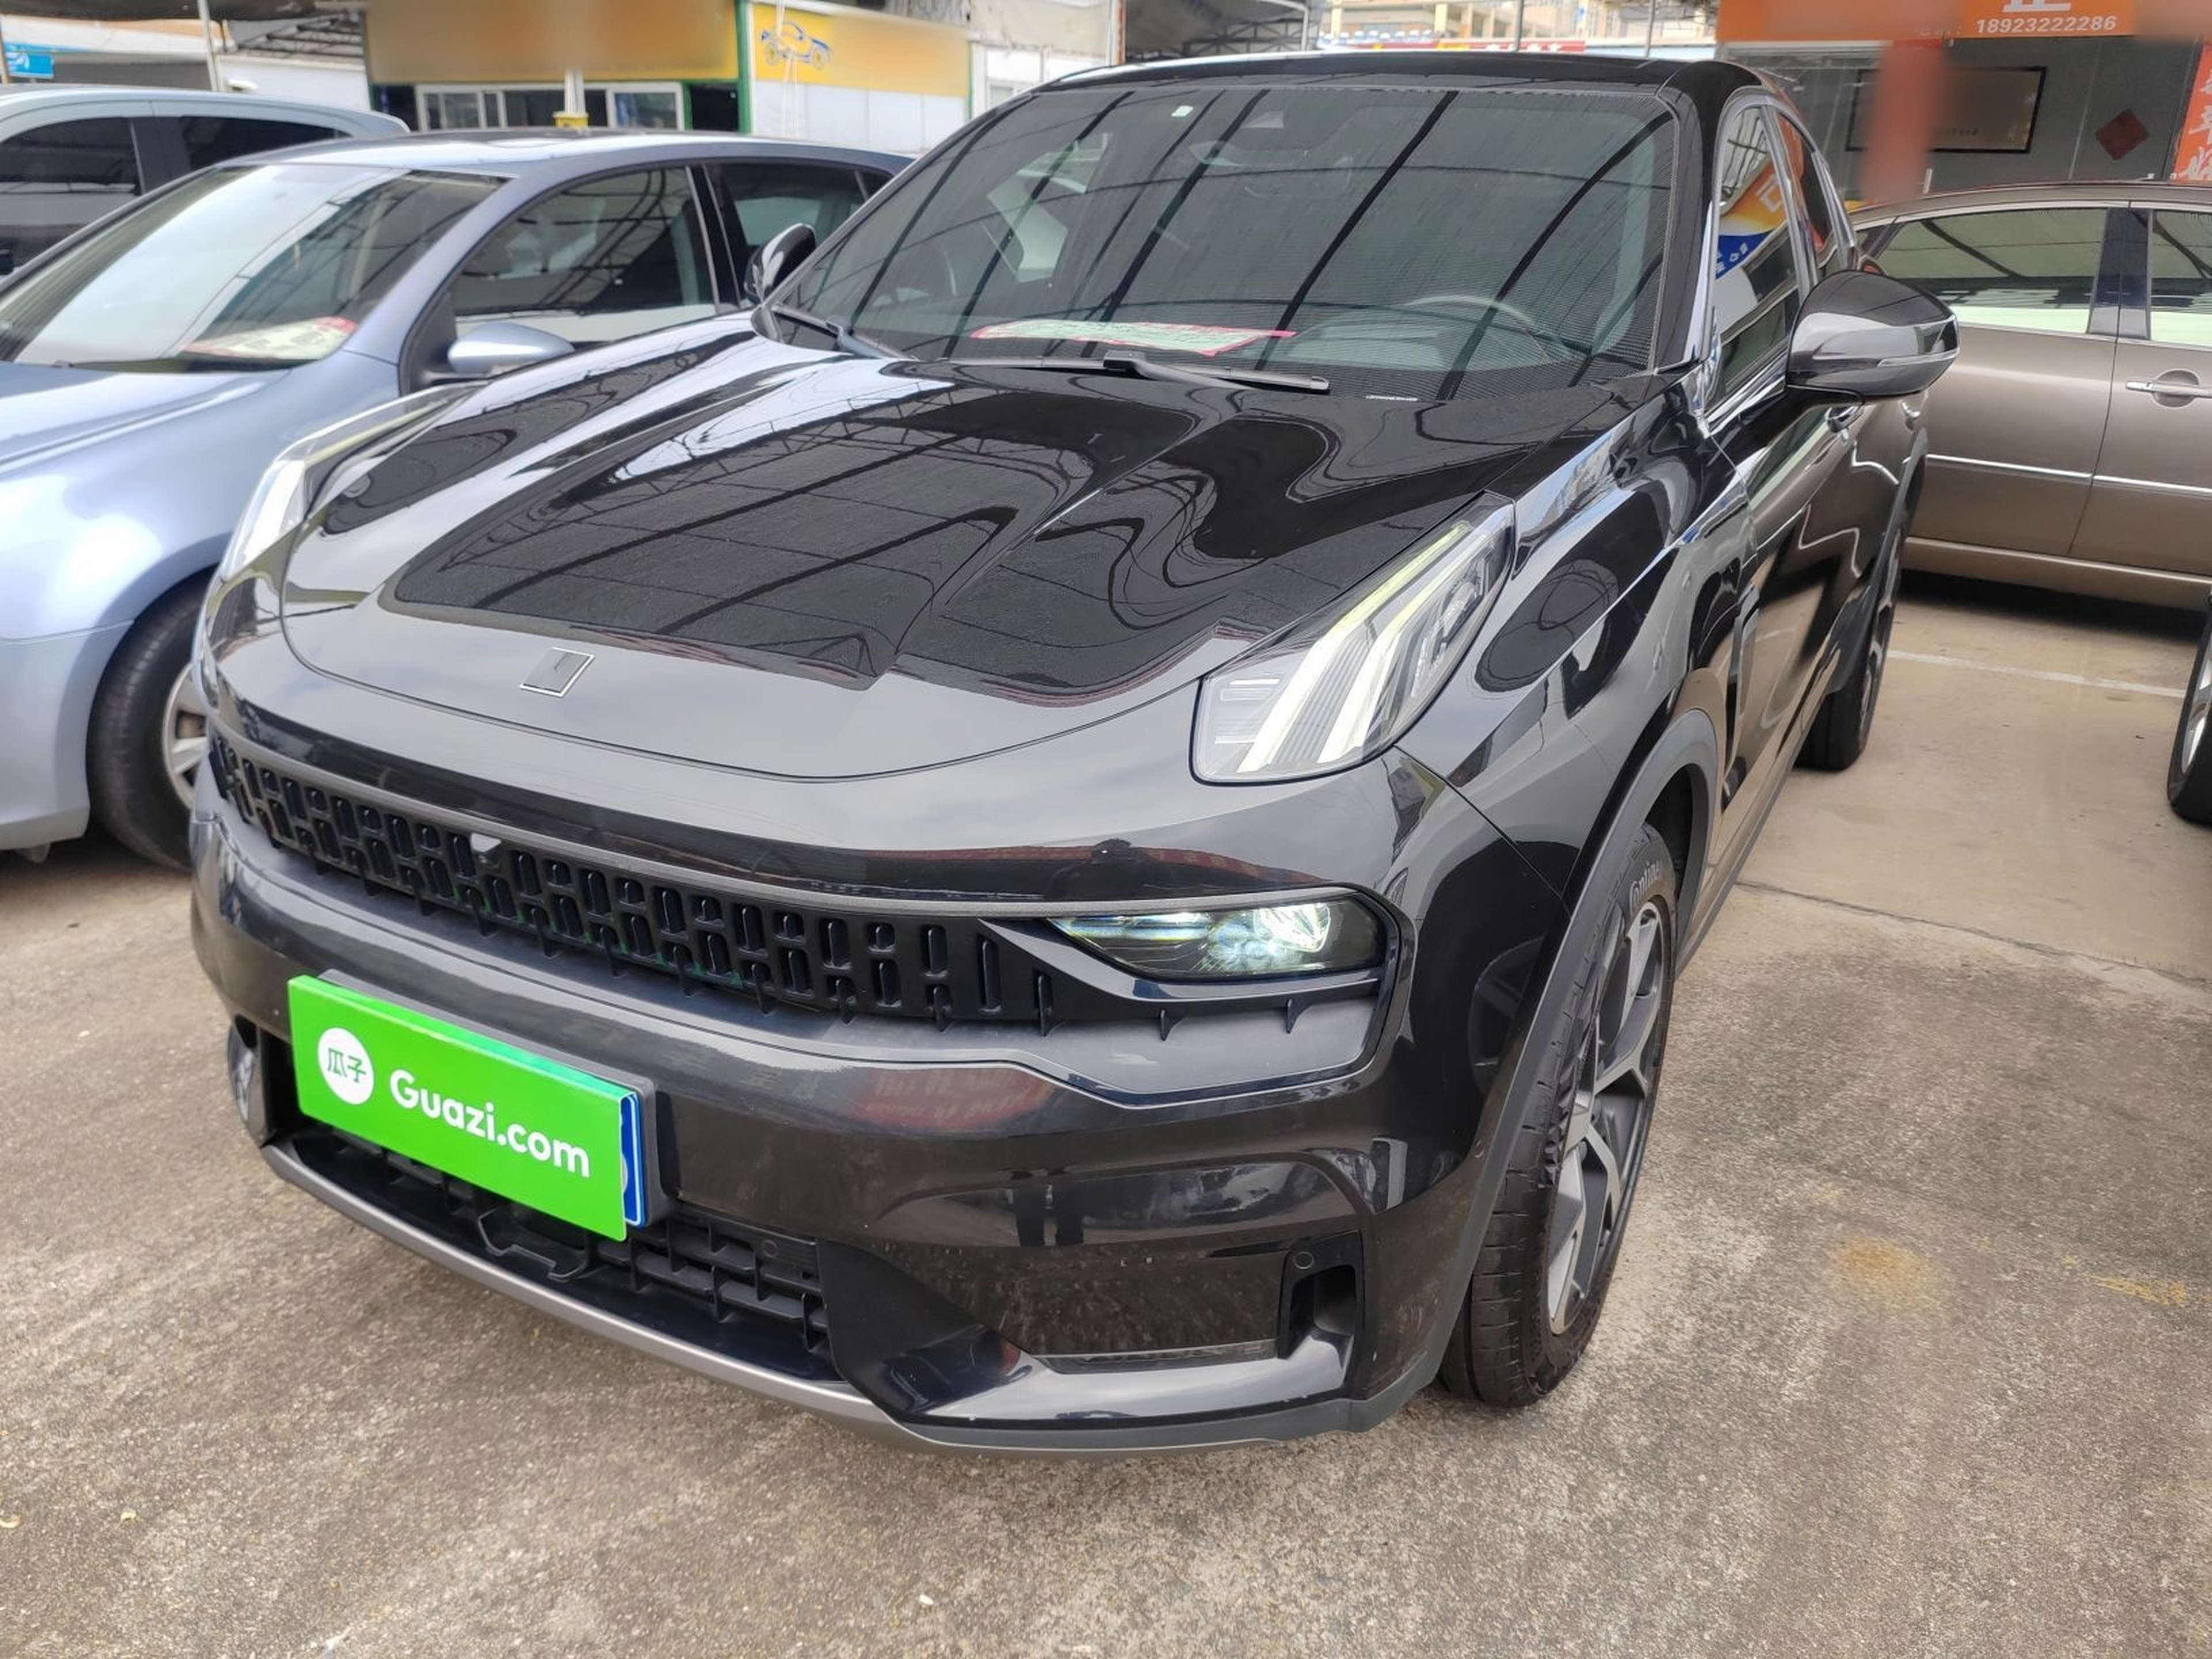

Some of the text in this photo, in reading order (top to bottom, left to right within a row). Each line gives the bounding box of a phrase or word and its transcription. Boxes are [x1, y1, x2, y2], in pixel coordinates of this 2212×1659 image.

[1976, 16, 2118, 33] 18923222286
[327, 1047, 367, 1084] 瓜子
[389, 1069, 590, 1178] Guazi.com
